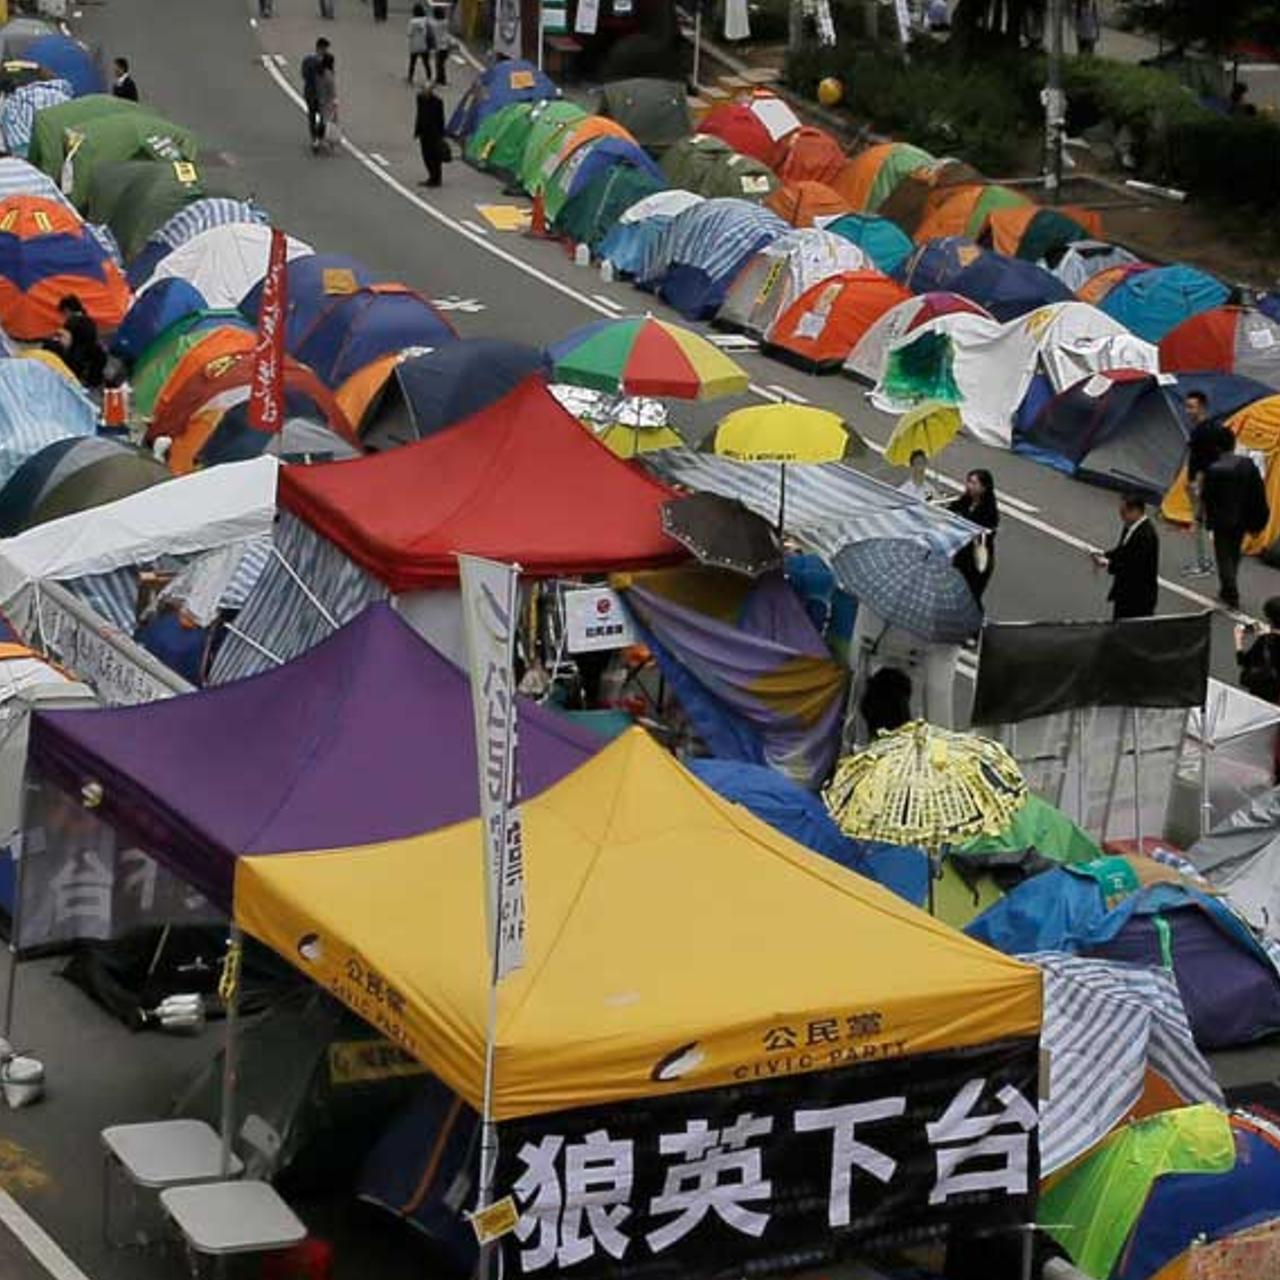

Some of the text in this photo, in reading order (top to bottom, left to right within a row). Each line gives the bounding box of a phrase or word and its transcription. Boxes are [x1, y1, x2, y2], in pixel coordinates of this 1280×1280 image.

[762, 1011, 884, 1052] 公民黨
[733, 1037, 910, 1081] CIVIC PARTY
[509, 1077, 1039, 1274] 狼英下台
